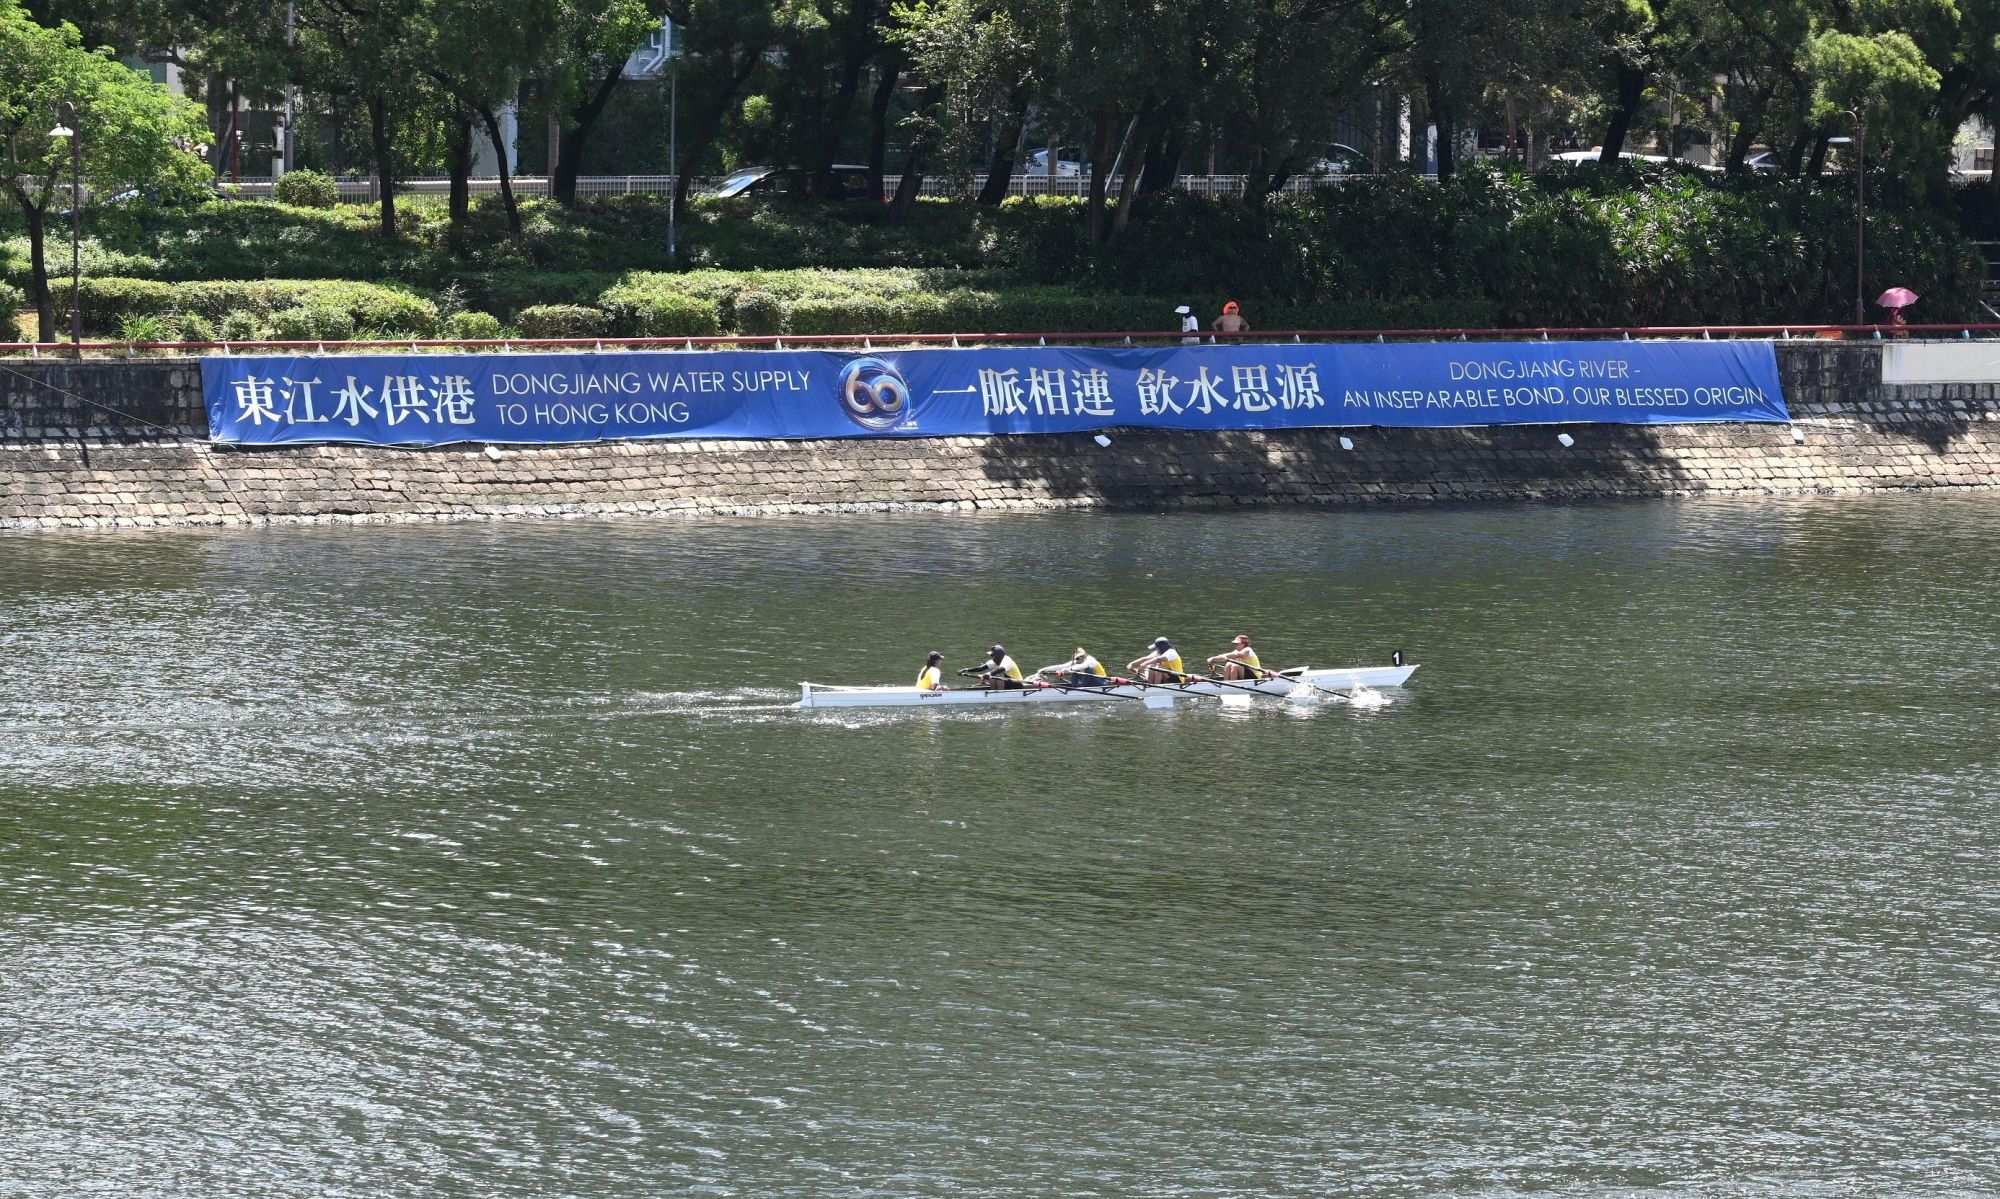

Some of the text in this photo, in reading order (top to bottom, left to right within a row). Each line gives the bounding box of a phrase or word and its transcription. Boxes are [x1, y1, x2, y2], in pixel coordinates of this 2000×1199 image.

[1449, 360, 1575, 380] DONGJIANG
[1579, 360, 1629, 379] RIVER
[492, 370, 811, 394] DONGJIANG WATER SUPPLY
[845, 364, 904, 413] 60
[932, 362, 1325, 416] 一脈相連 飲水思源
[230, 375, 476, 426] 東江水供港
[1343, 386, 1764, 409] AN INSEPARABLE BOND, OUR BLESSED ORIGIN
[496, 402, 690, 424] TO HONG KONG
[1393, 651, 1400, 665] 1
